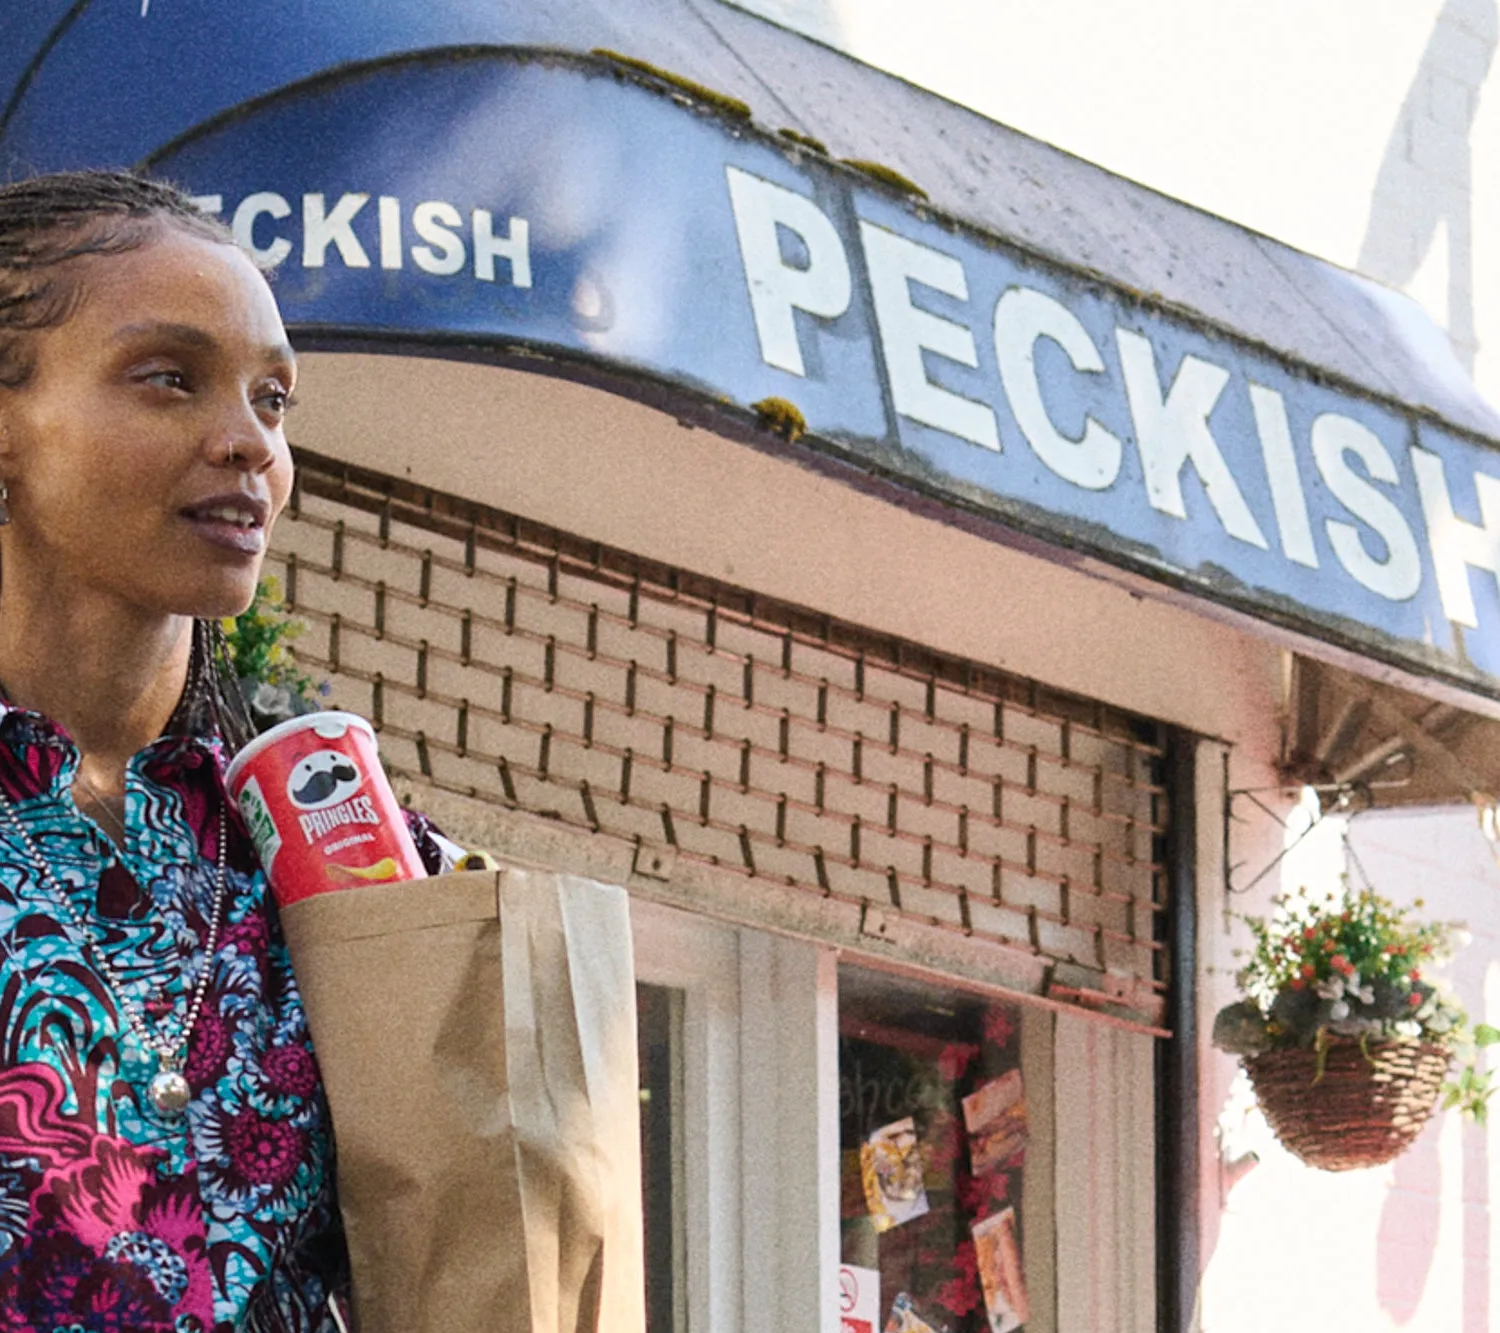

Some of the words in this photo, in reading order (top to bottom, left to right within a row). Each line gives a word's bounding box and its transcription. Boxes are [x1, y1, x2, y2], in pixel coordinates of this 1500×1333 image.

[190, 191, 532, 288] CKISH
[725, 165, 1500, 629] PECKISH
[298, 793, 380, 846] PRINGLES
